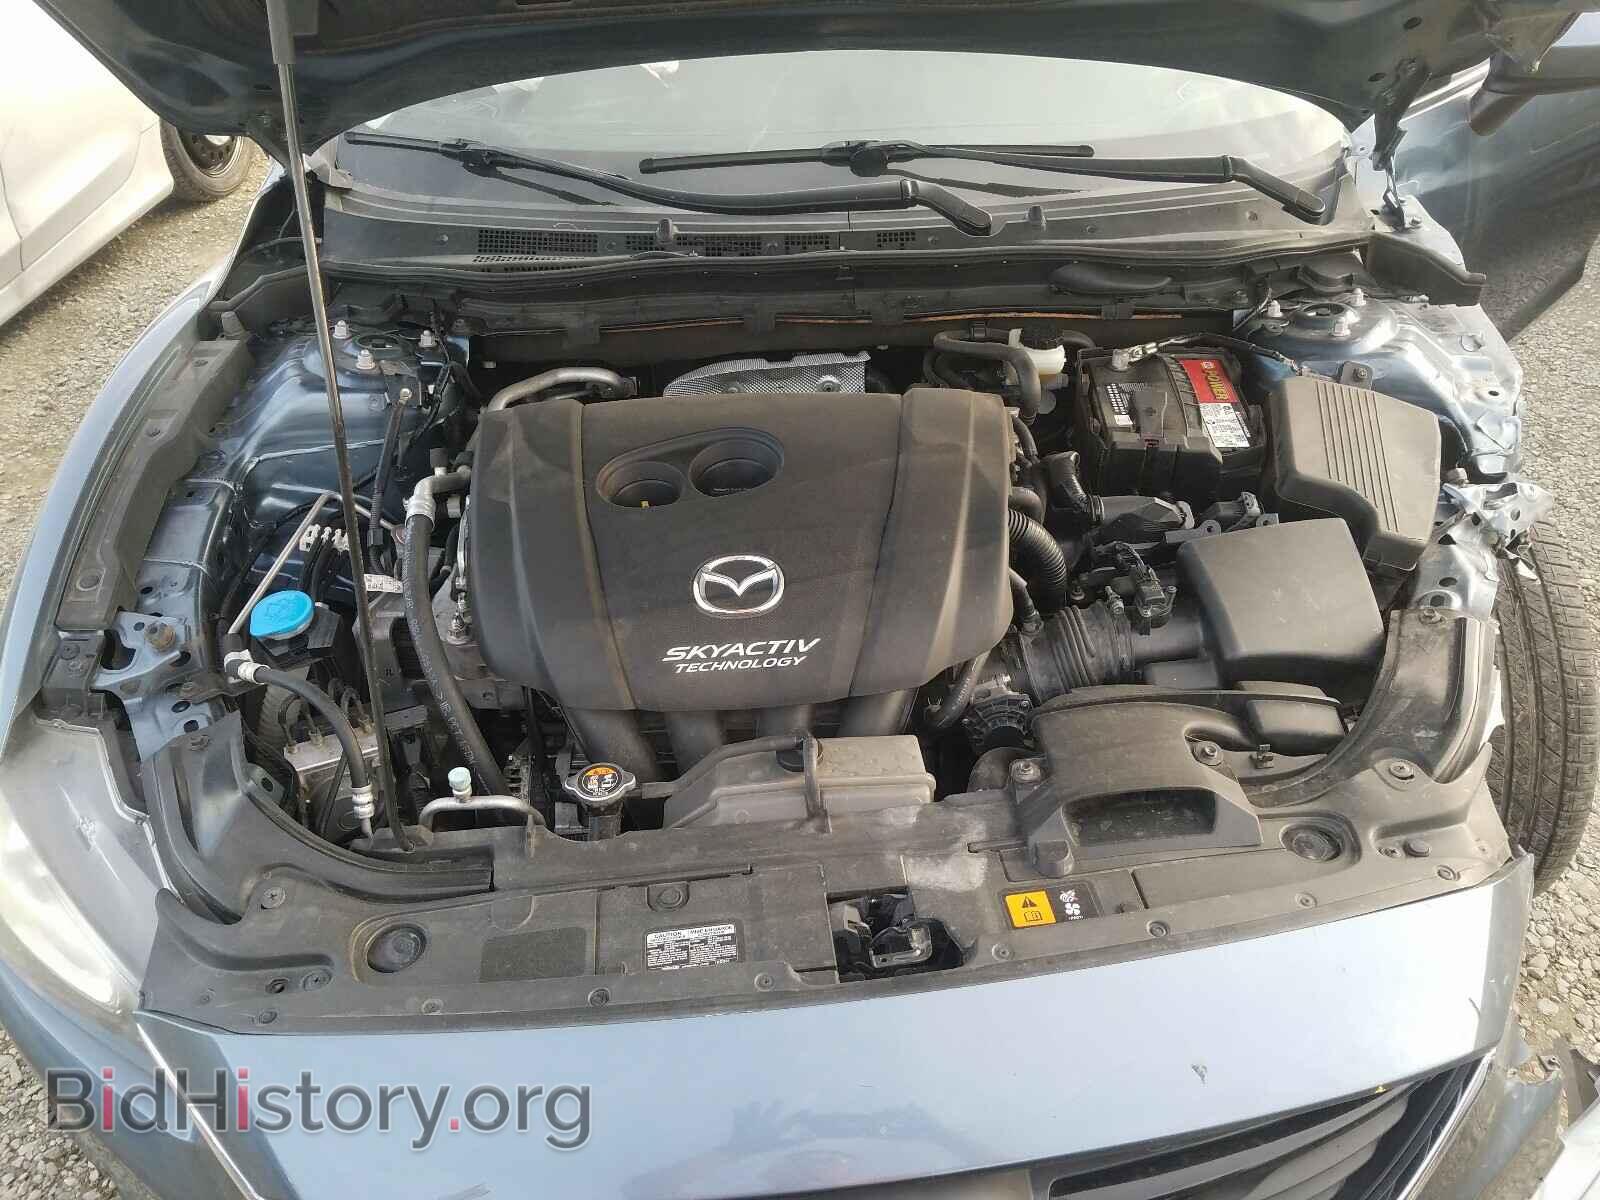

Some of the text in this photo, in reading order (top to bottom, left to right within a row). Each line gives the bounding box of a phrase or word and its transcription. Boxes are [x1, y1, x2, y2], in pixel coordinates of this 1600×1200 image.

[1204, 370, 1229, 400] POWER
[662, 638, 821, 662] SKYACTIV
[675, 656, 807, 673] TECHNOLOGY
